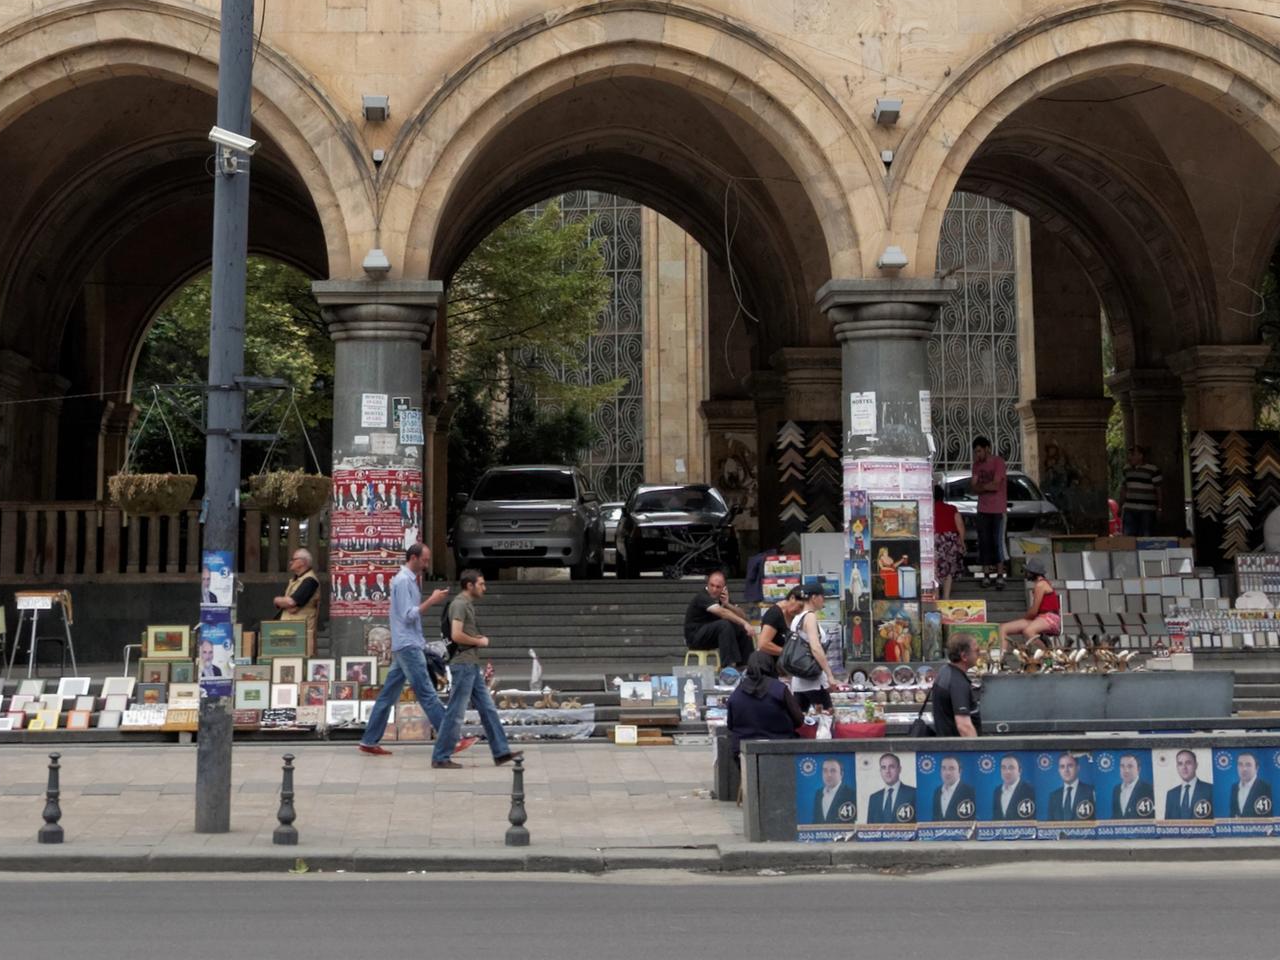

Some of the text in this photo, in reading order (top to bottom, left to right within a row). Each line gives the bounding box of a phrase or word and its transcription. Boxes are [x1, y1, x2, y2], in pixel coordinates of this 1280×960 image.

[959, 804, 972, 814] 41
[1019, 803, 1032, 813] 41
[1078, 804, 1091, 815] 41
[1138, 802, 1151, 812] 41
[1195, 803, 1209, 814] 41
[1256, 800, 1269, 810] 41
[840, 806, 853, 817] 41
[898, 807, 911, 818] 41
